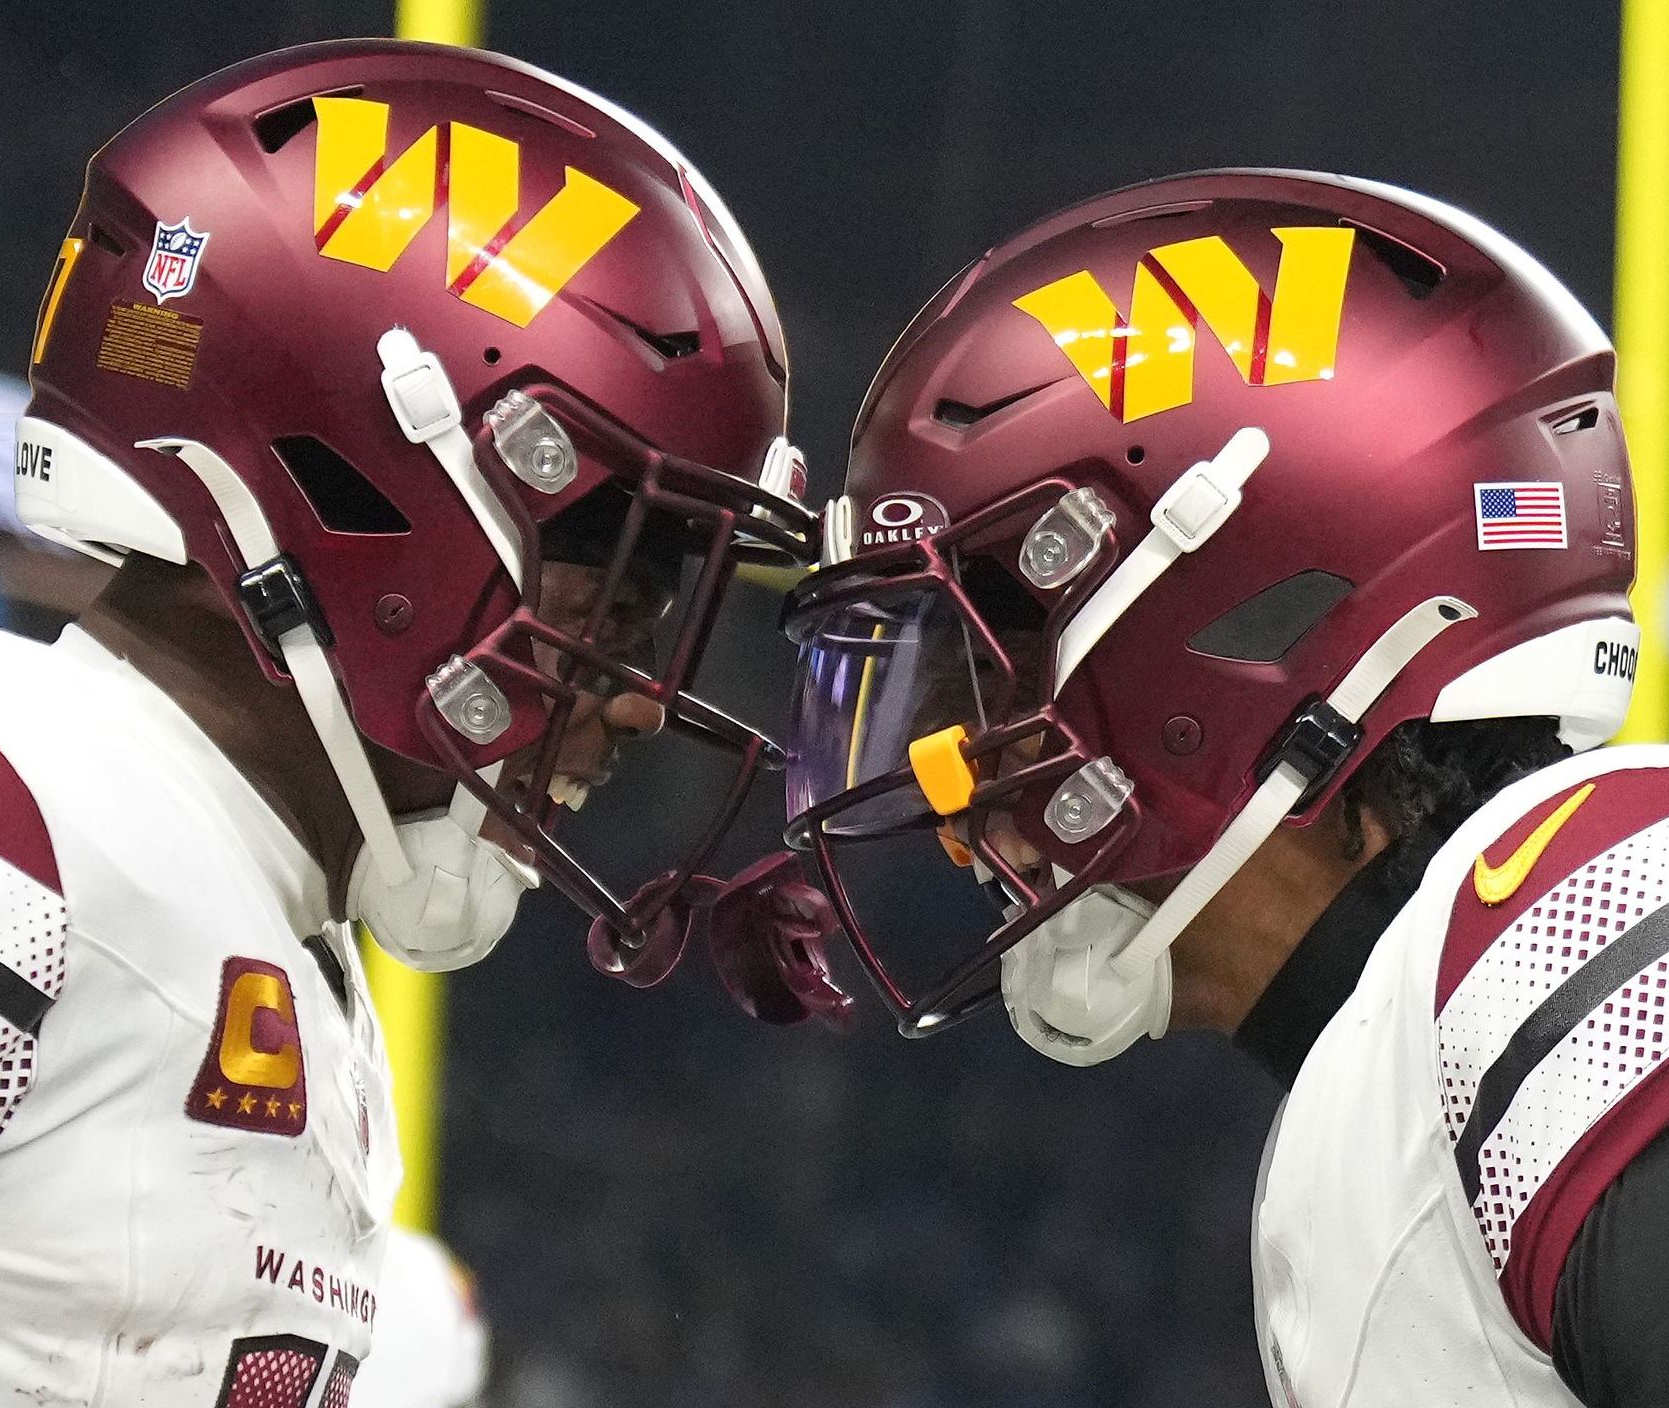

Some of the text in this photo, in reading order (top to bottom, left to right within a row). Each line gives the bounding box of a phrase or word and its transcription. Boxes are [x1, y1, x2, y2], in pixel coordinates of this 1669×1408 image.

[149, 252, 187, 288] NFL
[131, 303, 180, 321] WARNING
[15, 441, 53, 482] LOVE
[1593, 640, 1639, 685] CHOO
[218, 971, 302, 1089] C
